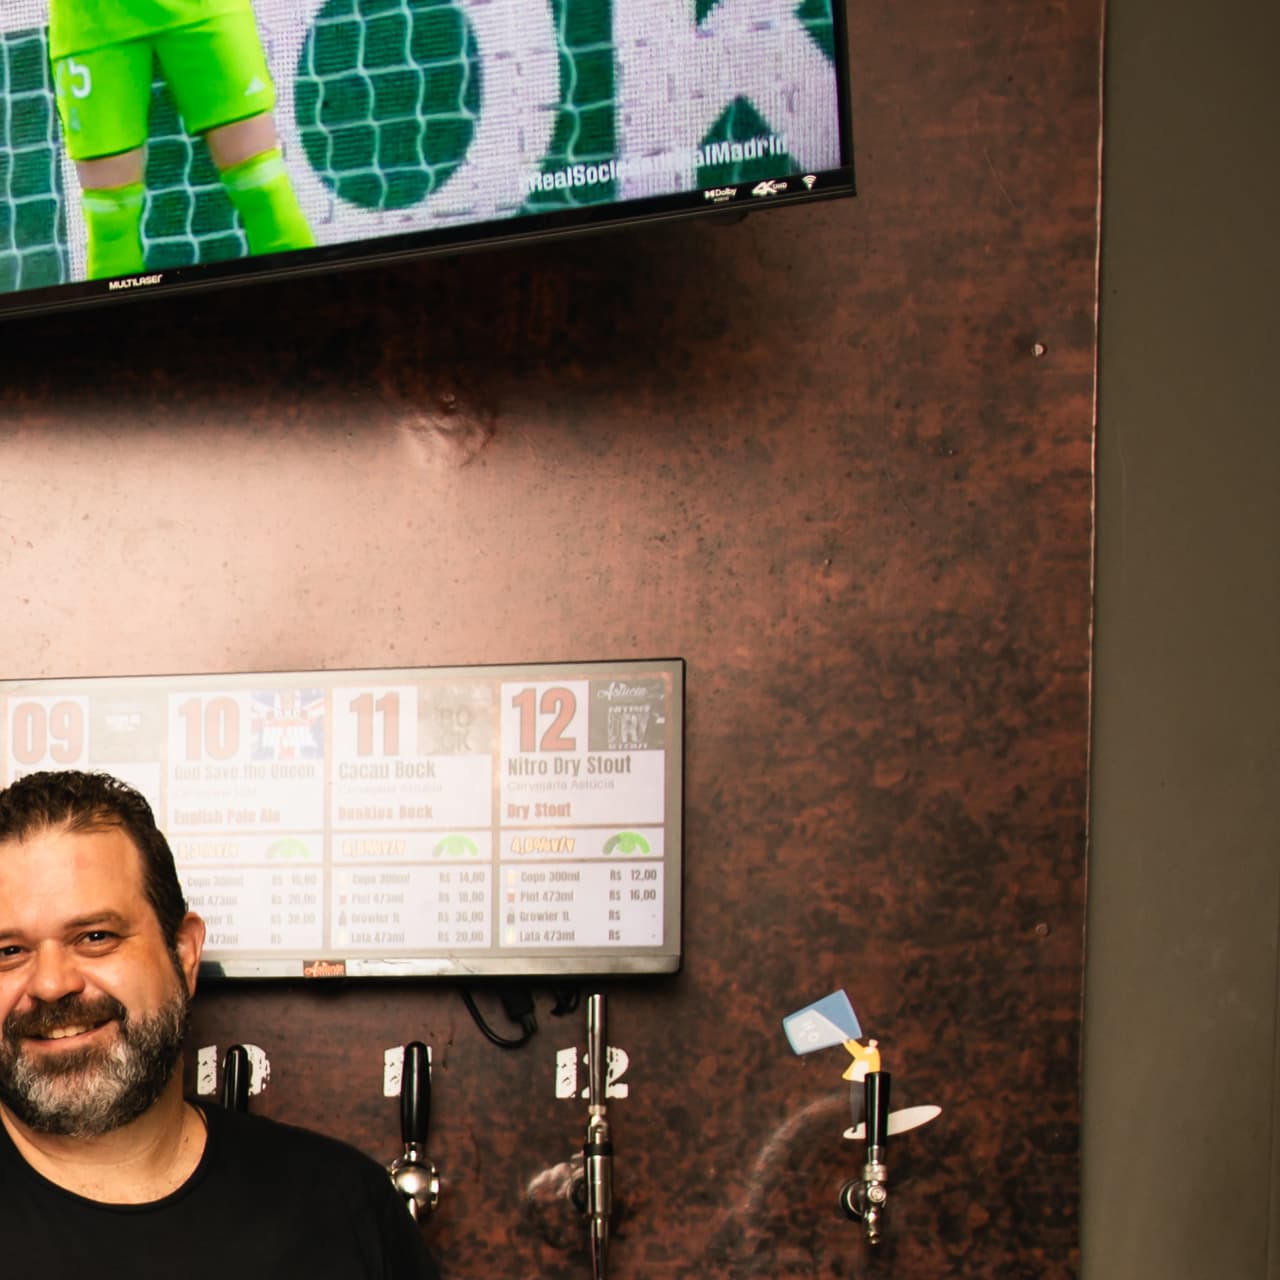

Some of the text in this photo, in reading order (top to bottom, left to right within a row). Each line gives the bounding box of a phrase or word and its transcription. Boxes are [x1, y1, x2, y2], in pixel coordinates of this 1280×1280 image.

[12, 700, 84, 765] 09
[178, 696, 240, 761] 10
[350, 692, 400, 756] 11
[512, 687, 577, 752] 12
[508, 755, 631, 777] Nitro Dry Stout
[535, 802, 571, 817] Stout
[556, 1045, 629, 1099] 12
